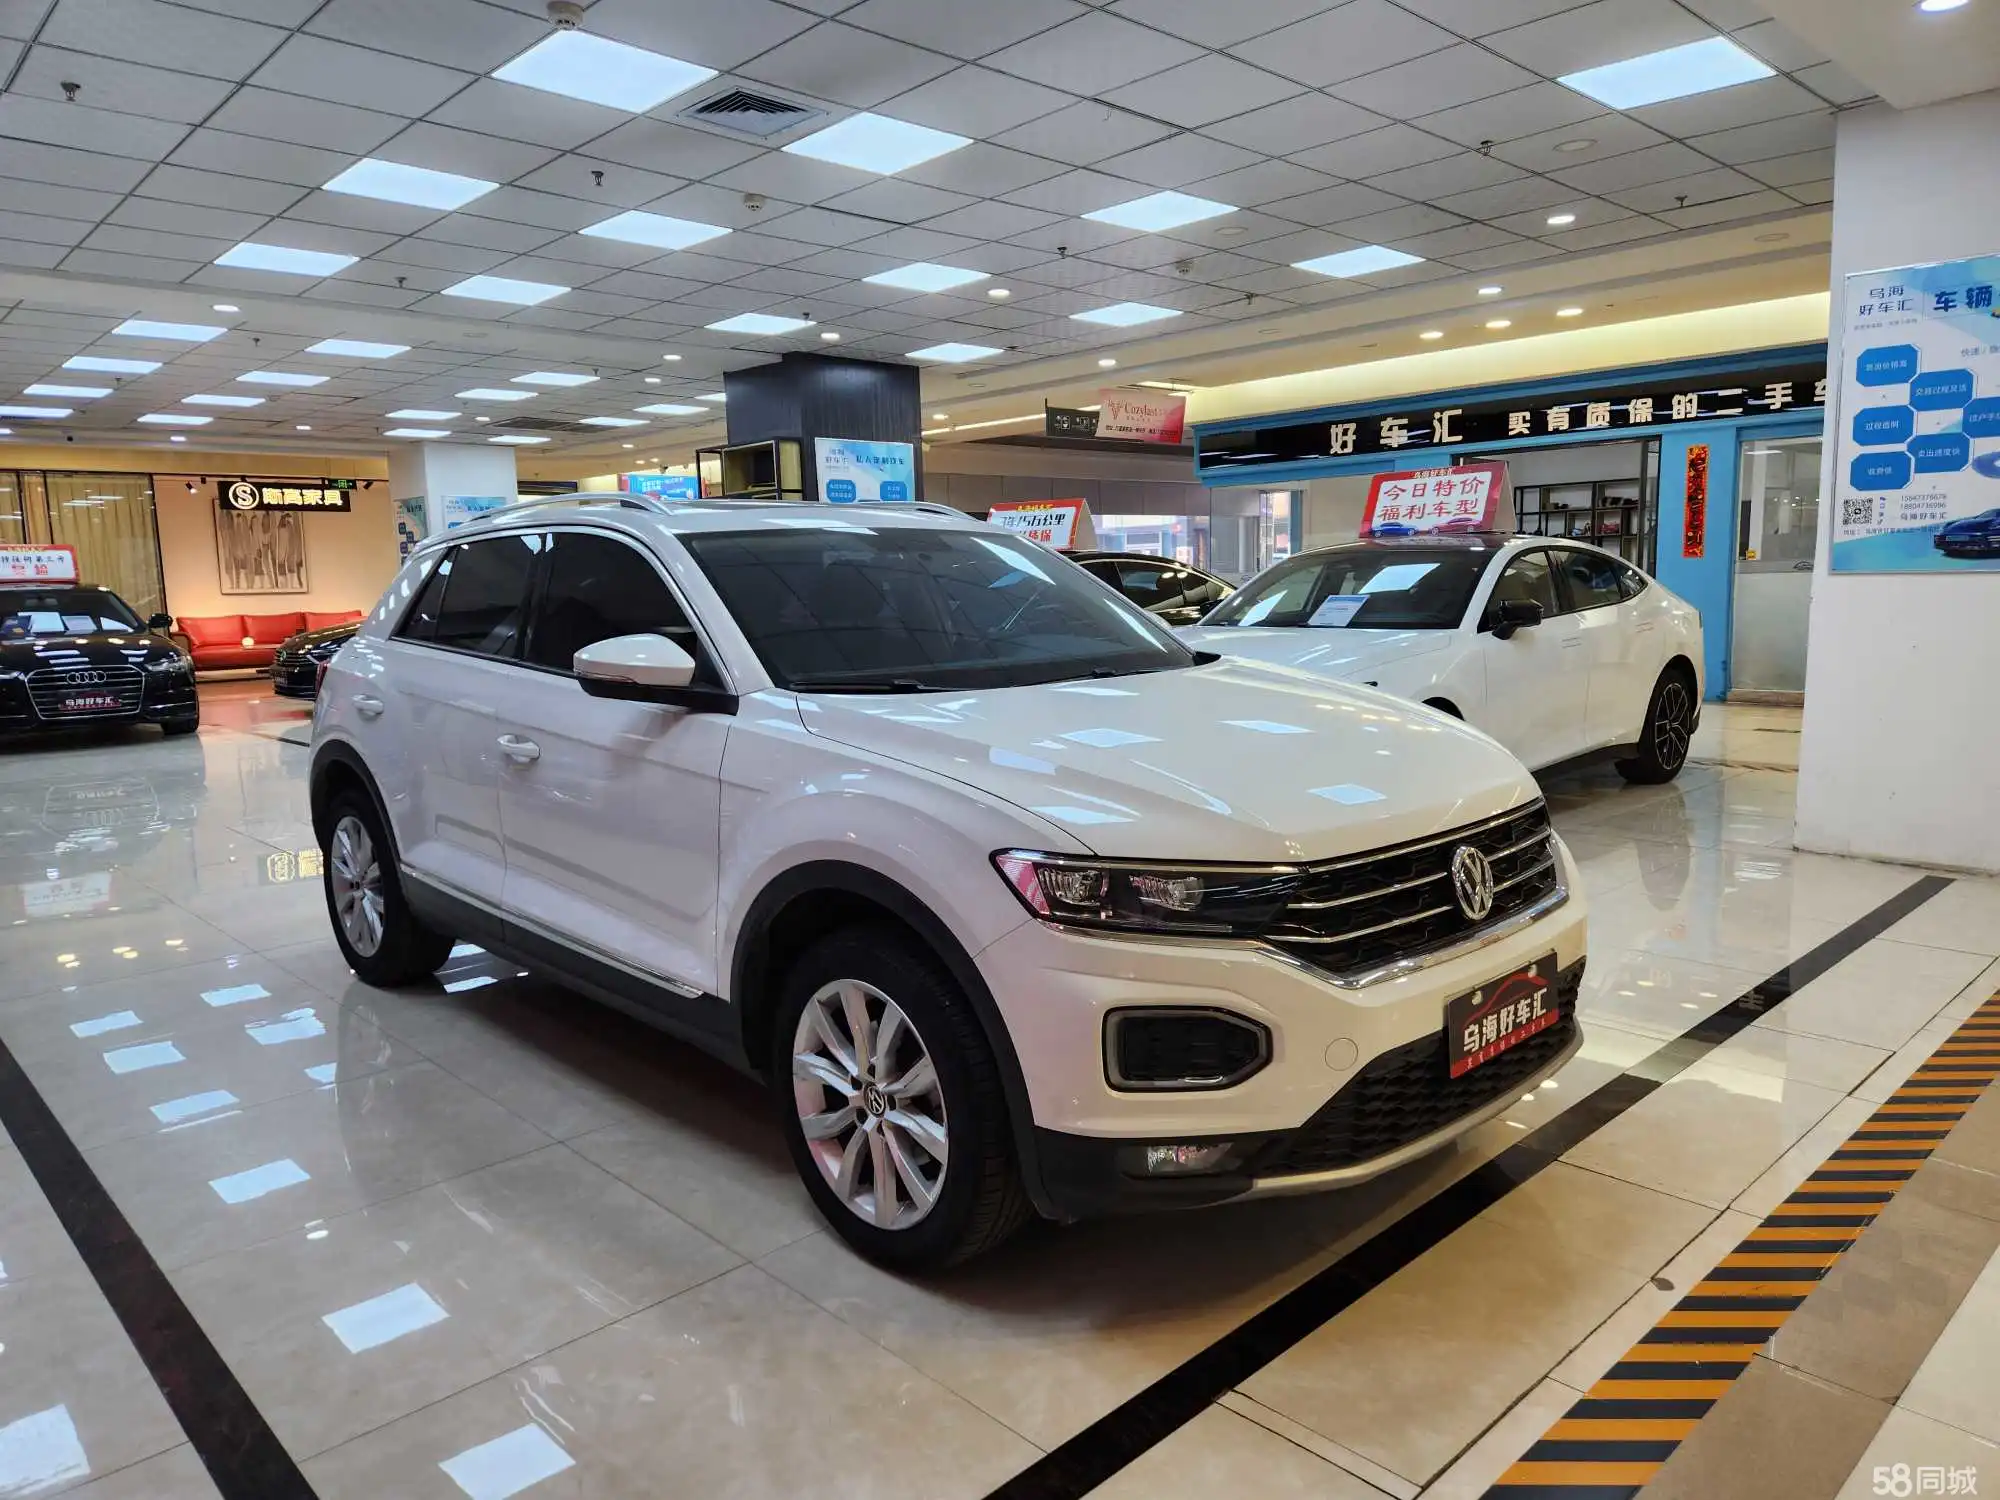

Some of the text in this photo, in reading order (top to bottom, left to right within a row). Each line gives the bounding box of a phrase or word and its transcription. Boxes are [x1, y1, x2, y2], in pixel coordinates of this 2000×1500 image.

[1870, 285, 1904, 299] 乌海
[1933, 285, 1993, 313] 车辆
[1859, 299, 1914, 317] 好车汇
[1330, 409, 1462, 455] 好车汇
[1383, 475, 1485, 501] 今日特价
[1377, 498, 1479, 521] 福利车型
[1463, 987, 1548, 1053] 乌海好车汇
